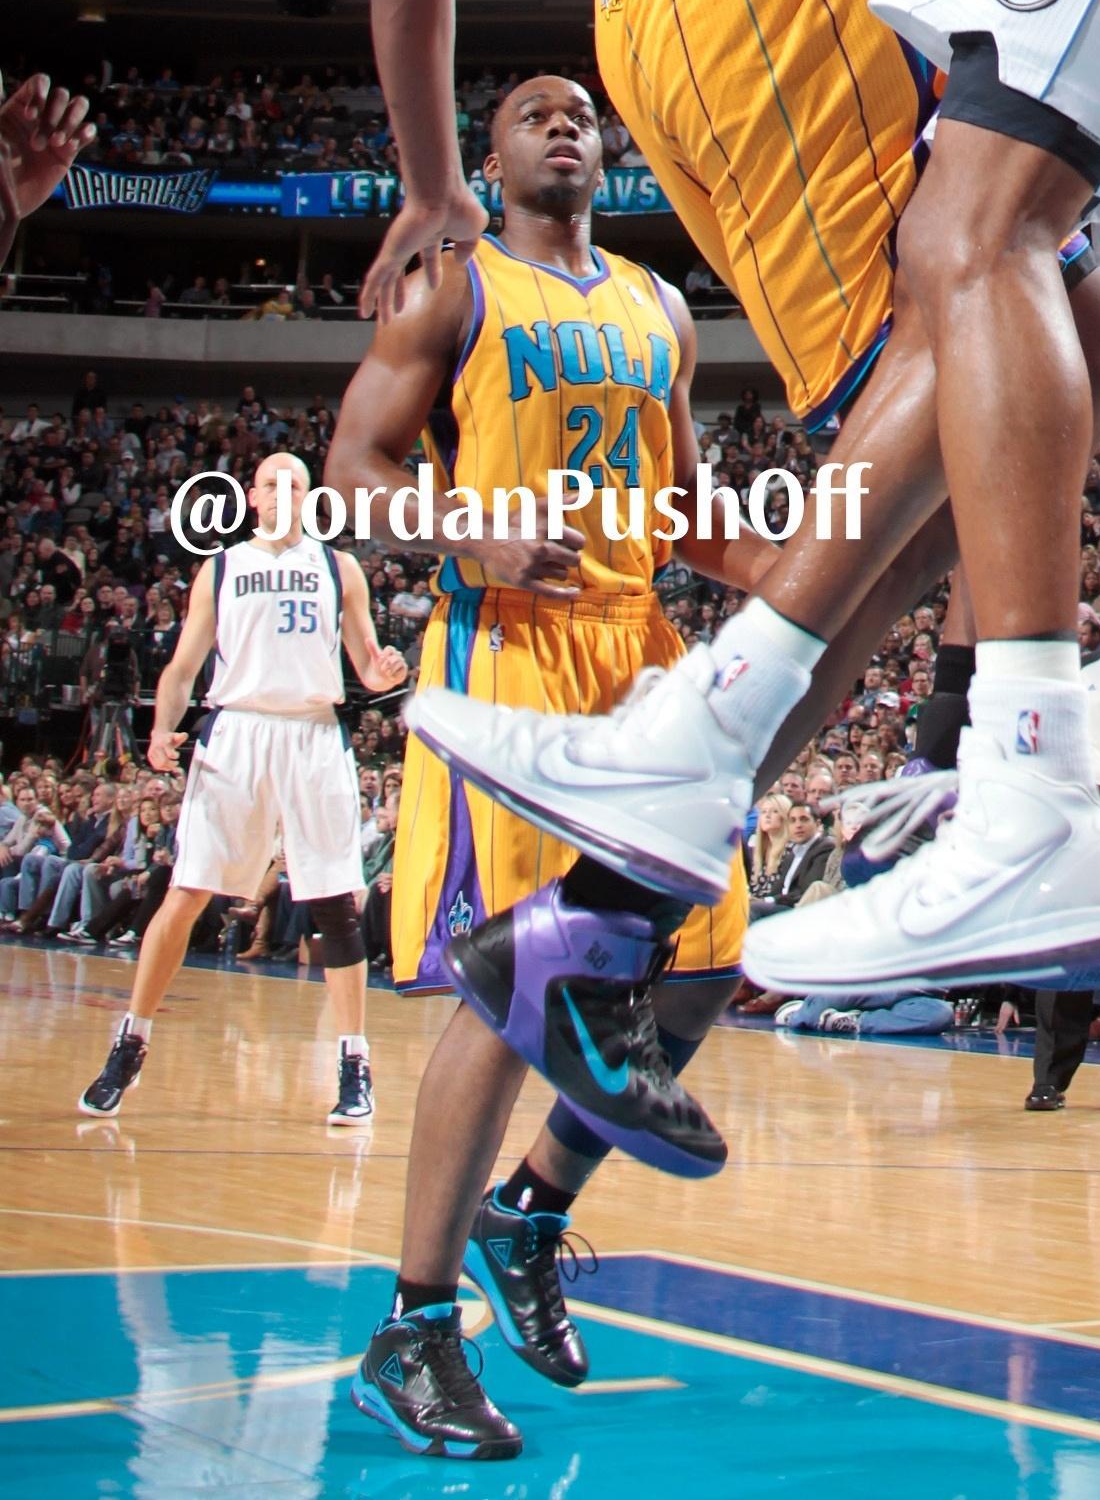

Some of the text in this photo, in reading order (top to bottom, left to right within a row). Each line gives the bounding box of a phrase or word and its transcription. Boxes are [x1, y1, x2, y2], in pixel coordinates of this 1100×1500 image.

[330, 176, 405, 211] LET
[592, 174, 657, 209] AVS
[502, 320, 673, 408] NOLA
[566, 406, 640, 489] 24
[235, 569, 319, 598] DALLAS
[277, 599, 318, 634] 35
